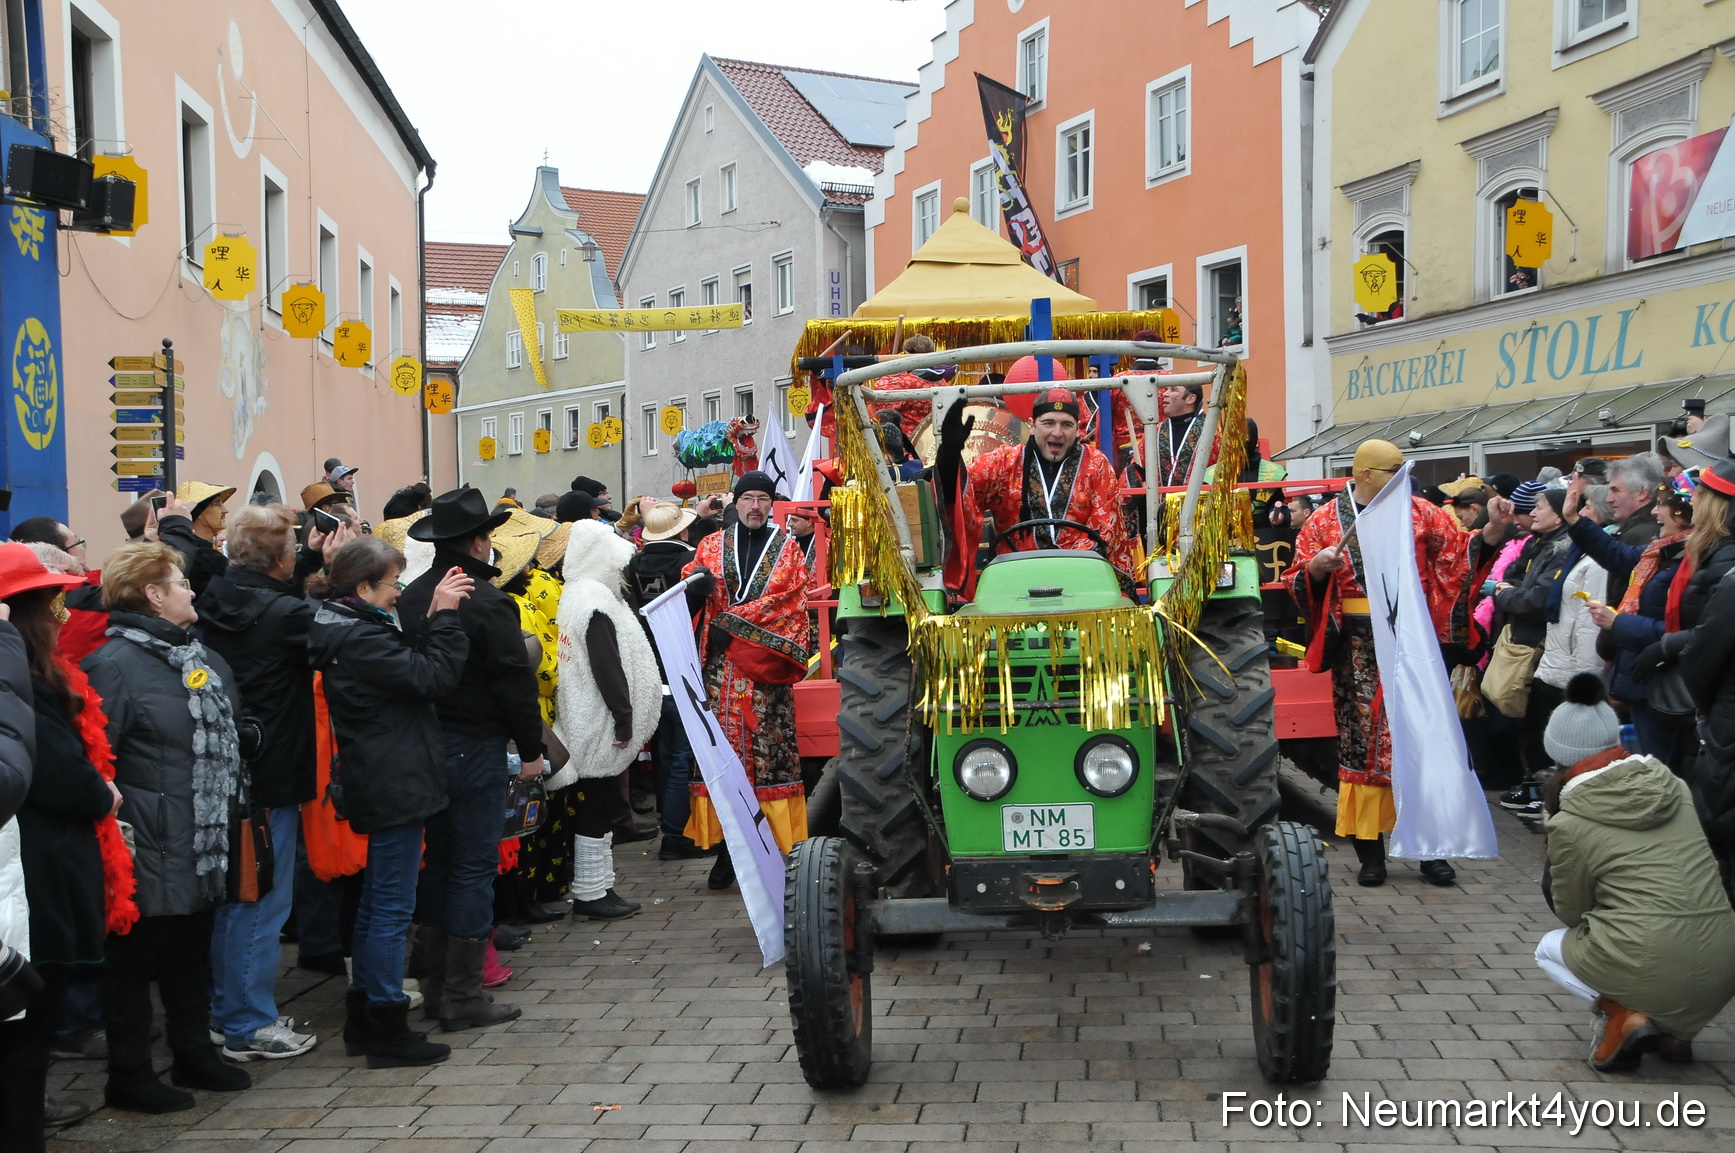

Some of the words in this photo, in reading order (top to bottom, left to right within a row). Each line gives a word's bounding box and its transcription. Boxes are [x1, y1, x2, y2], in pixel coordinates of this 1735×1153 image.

[1706, 198, 1735, 216] NEUE
[831, 271, 841, 315] UHR
[1346, 348, 1467, 401] BÄCKEREI
[1495, 308, 1644, 390] STOLL
[1030, 808, 1066, 827] NM
[1013, 829, 1045, 848] MT
[1058, 828, 1086, 847] 85
